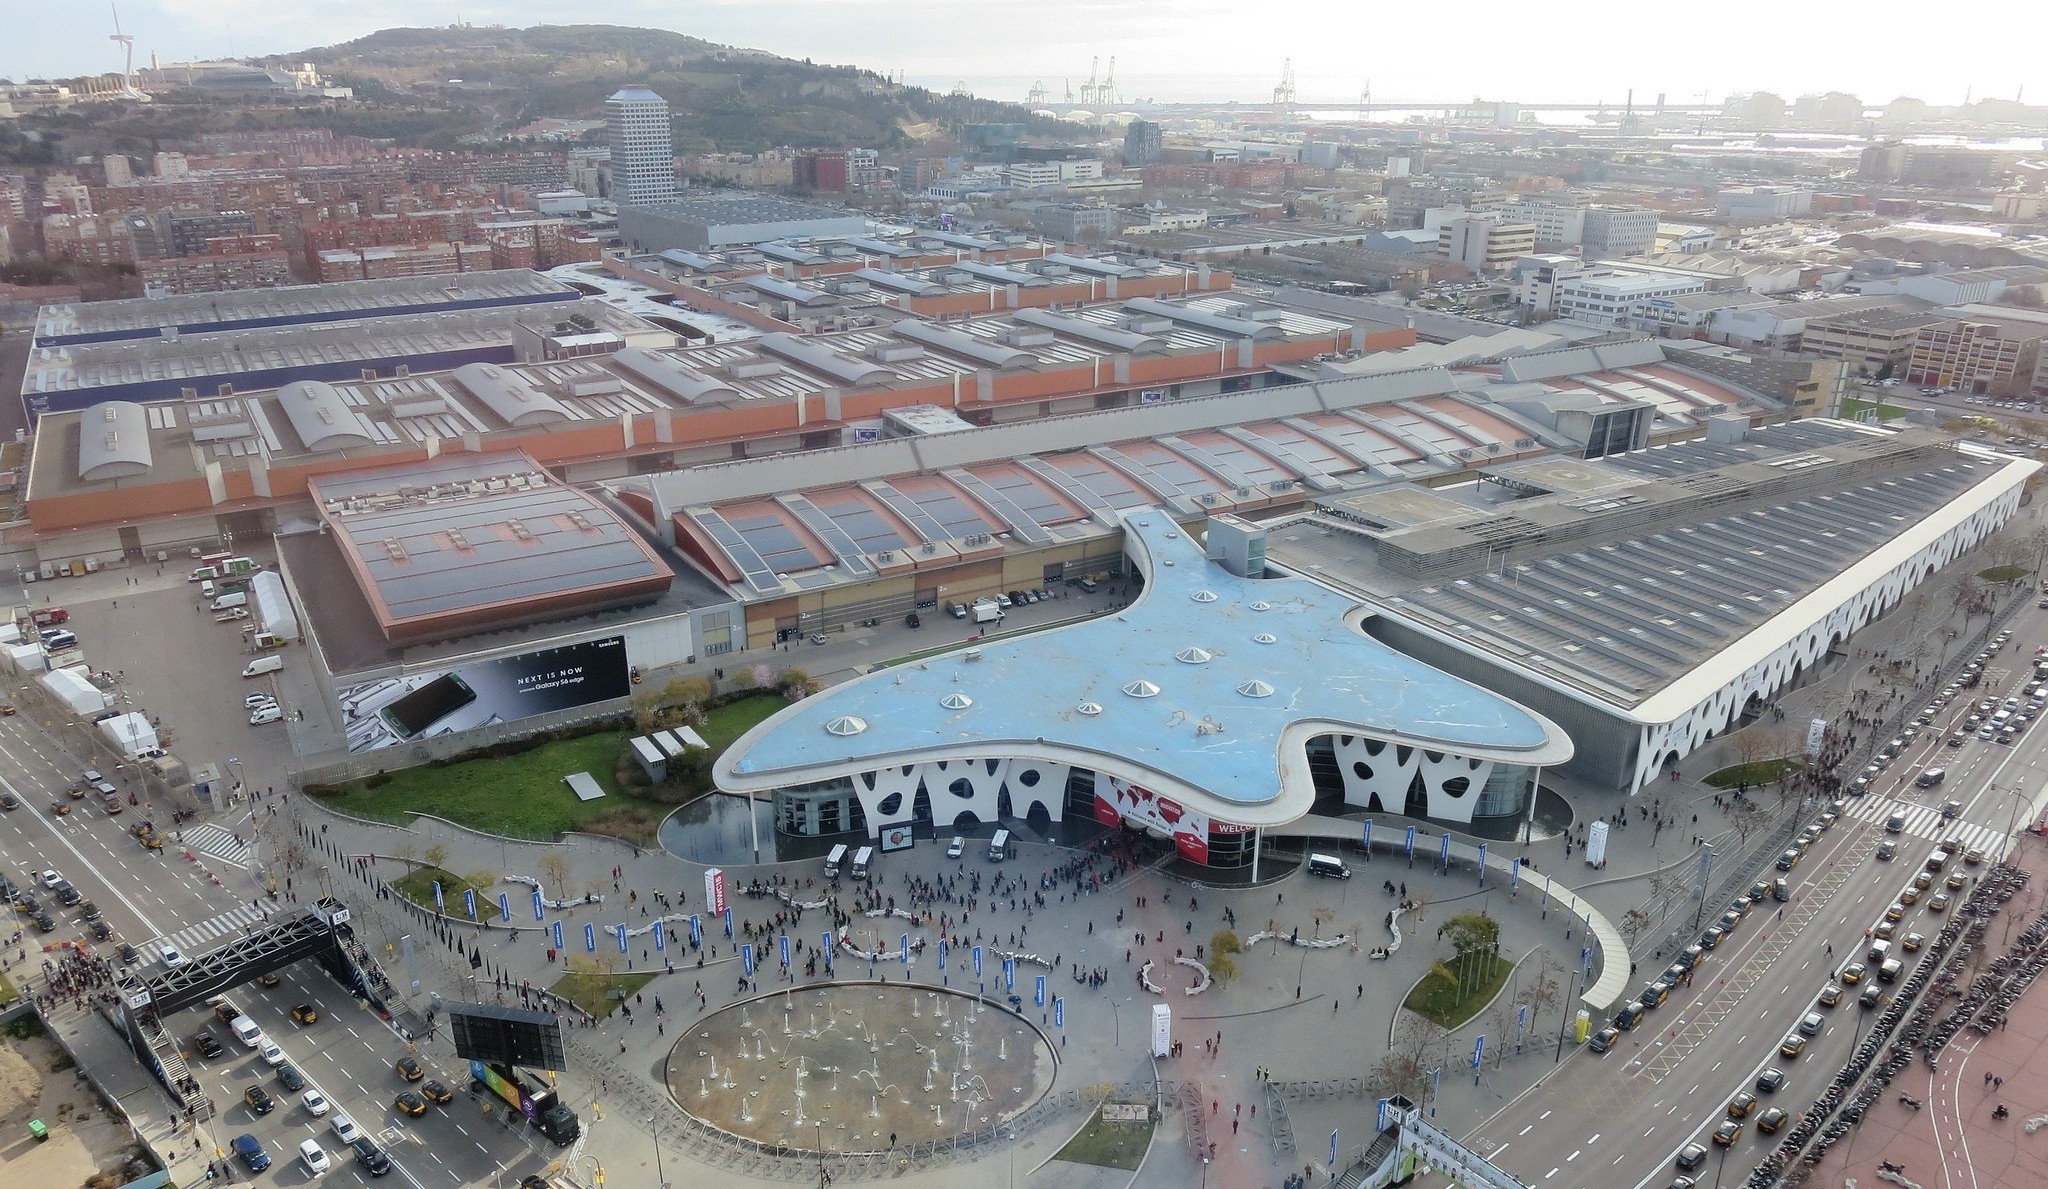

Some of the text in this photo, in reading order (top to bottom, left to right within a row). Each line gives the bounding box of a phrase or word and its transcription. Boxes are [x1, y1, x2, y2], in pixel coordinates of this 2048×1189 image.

[517, 666, 583, 685] NEXT IS NOW
[535, 679, 560, 690] Galaxy
[560, 678, 569, 686] S6
[569, 675, 585, 685] edge
[1218, 823, 1256, 833] WELCO
